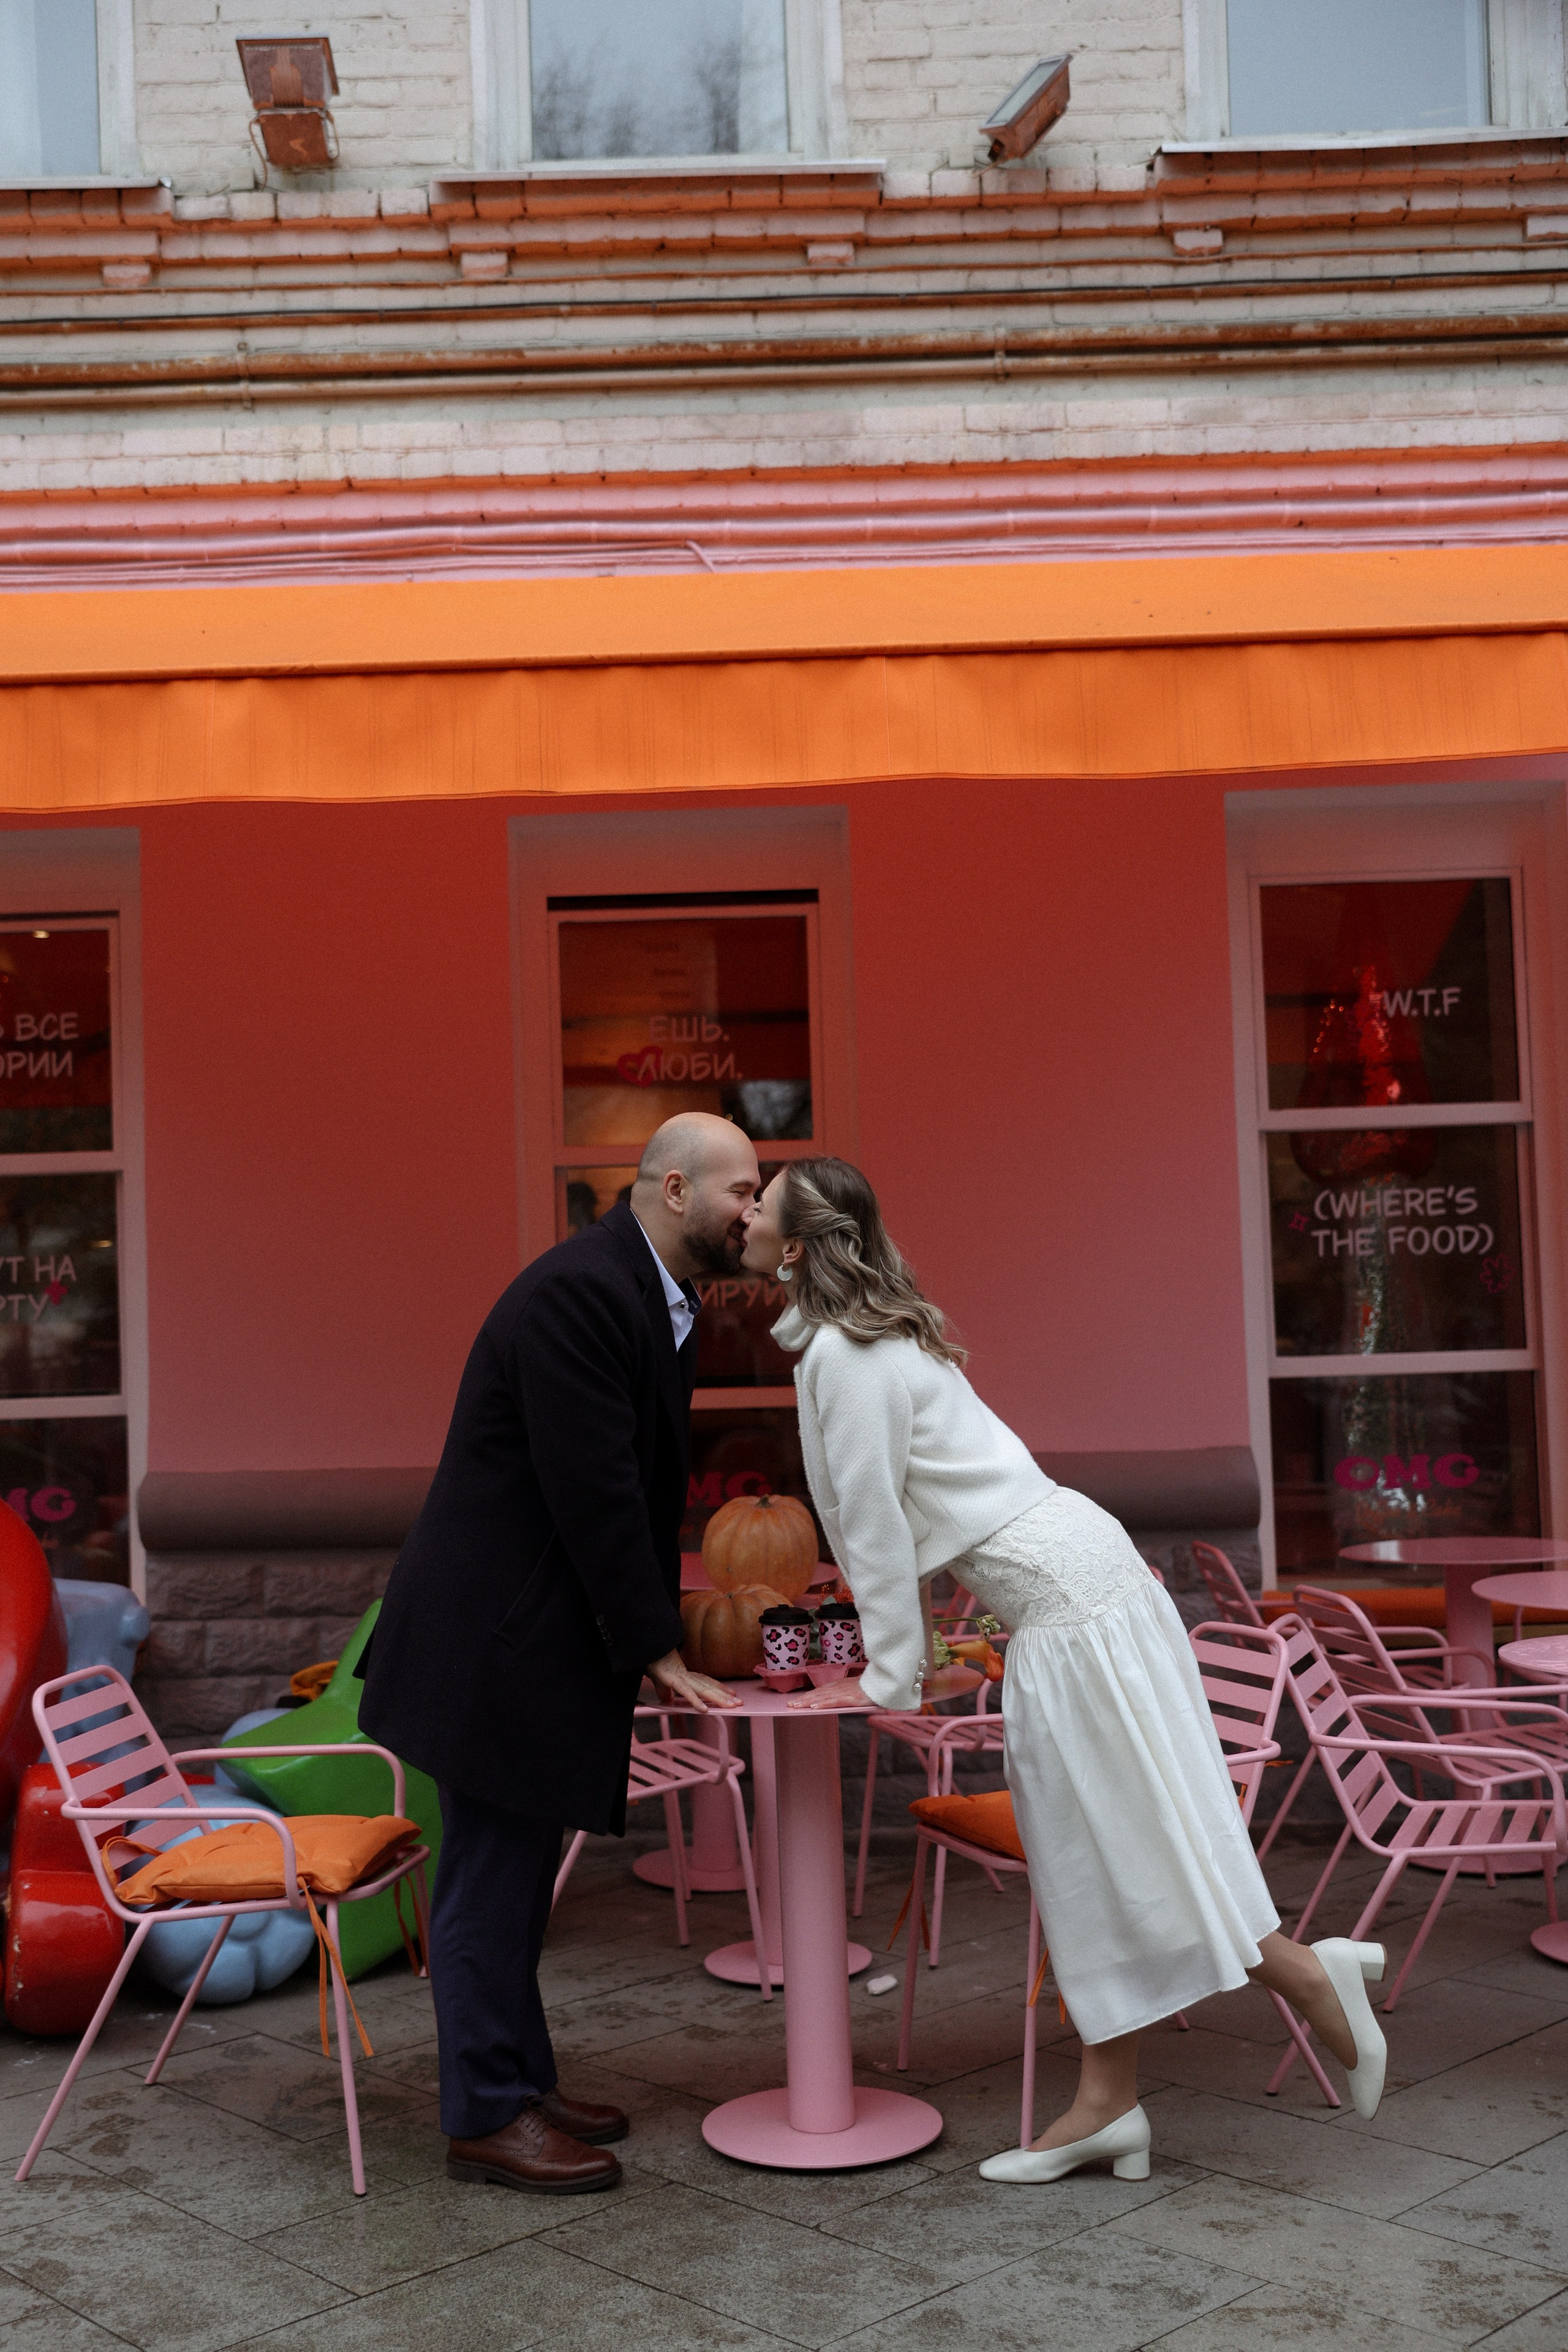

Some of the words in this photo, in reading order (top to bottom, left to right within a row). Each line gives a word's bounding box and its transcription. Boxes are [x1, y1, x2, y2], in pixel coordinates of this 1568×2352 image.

[1383, 986, 1462, 1019] W.T.F
[15, 1012, 80, 1042] ВСЕ
[648, 1014, 730, 1044] ЕШЬ.
[0, 1049, 74, 1079] РИИ
[637, 1052, 744, 1082] ЛЮБИ.
[1314, 1185, 1479, 1221] (WHERE'S
[1311, 1226, 1376, 1258] THE
[1387, 1223, 1494, 1256] FOOD)
[34, 1254, 78, 1283] НА
[697, 1276, 787, 1309] ИРУЙ
[1333, 1452, 1480, 1491] OMG
